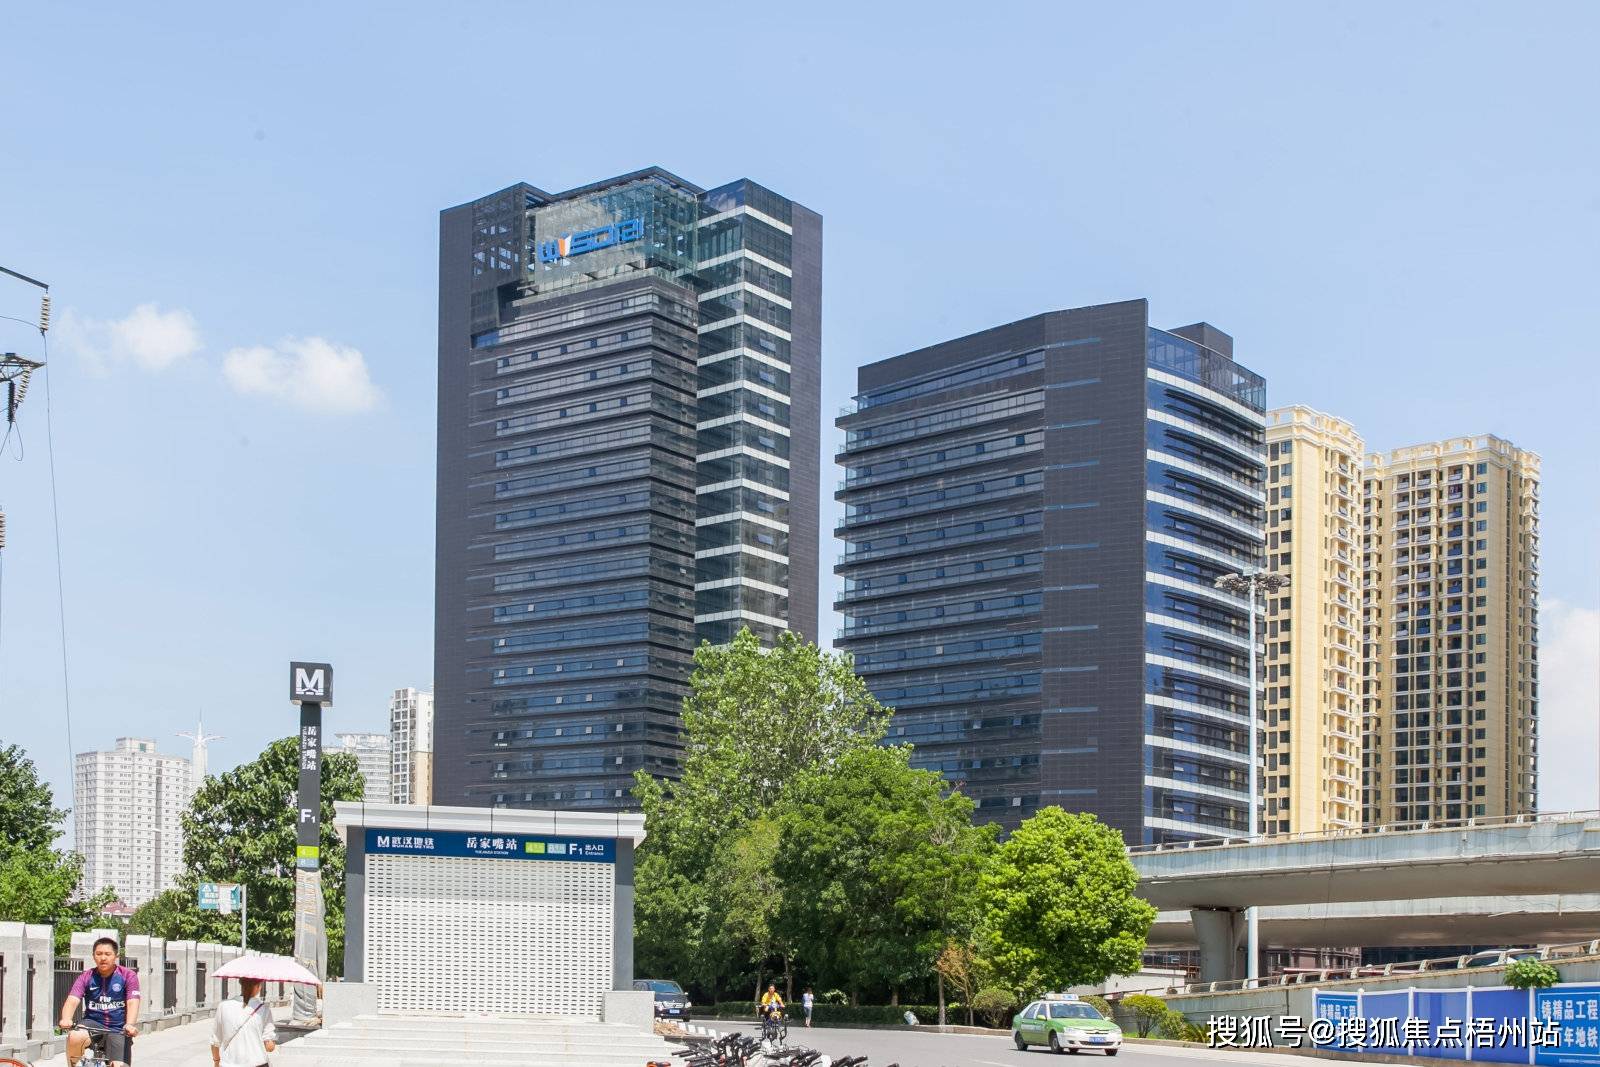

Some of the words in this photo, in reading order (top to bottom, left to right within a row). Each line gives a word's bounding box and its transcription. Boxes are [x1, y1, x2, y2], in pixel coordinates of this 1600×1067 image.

[300, 808, 316, 823] F1
[391, 836, 435, 846] 武汉地铁
[466, 836, 518, 850] 岳家嘴站
[569, 843, 583, 855] F1
